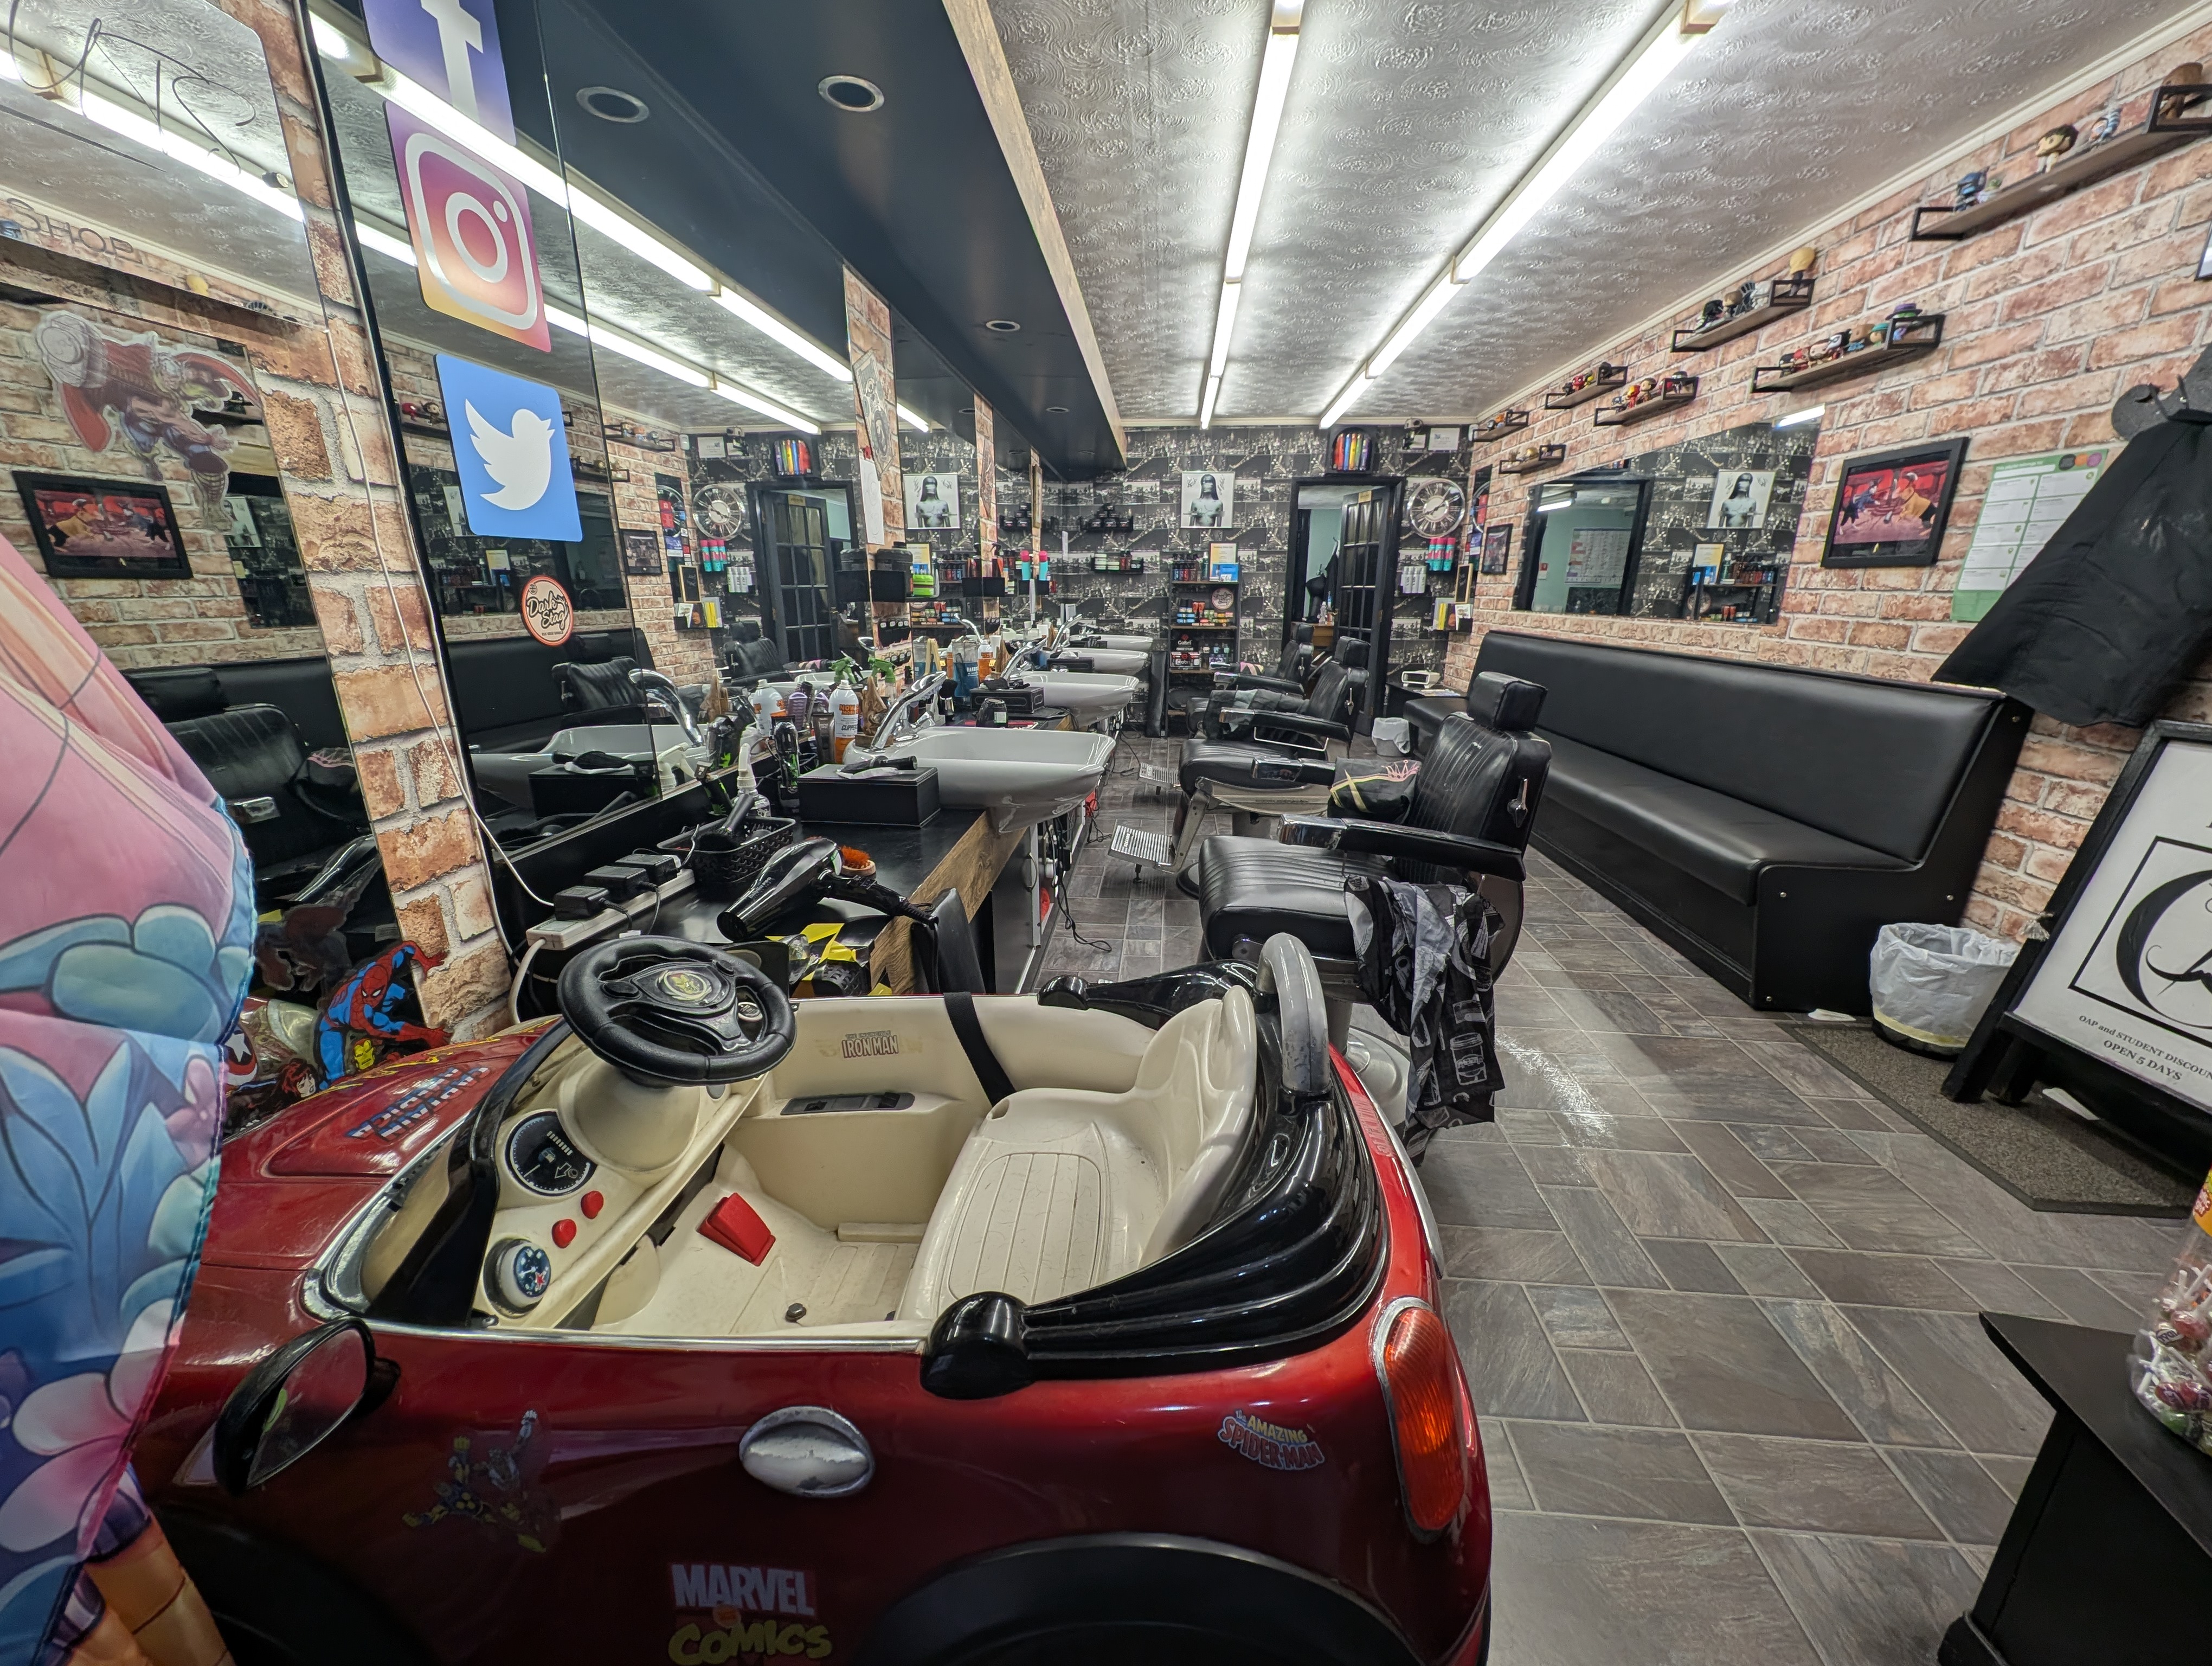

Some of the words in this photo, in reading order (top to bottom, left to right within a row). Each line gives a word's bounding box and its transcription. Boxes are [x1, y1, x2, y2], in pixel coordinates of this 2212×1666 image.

[7, 197, 134, 255] SHOP
[526, 590, 557, 618] Dark
[541, 609, 566, 631] Stag
[841, 1038, 872, 1059] IRON
[872, 1035, 899, 1056] MAN
[2079, 1015, 2099, 1027] OAP
[2098, 1024, 2117, 1035] and
[2115, 1032, 2165, 1058] STUDENT
[2104, 1040, 2137, 1060] OPEN
[2136, 1056, 2146, 1066] 5
[2146, 1059, 2183, 1081] DAYS
[1219, 1417, 1324, 1469] SPIDER-MAN
[1248, 1415, 1308, 1443] AMAZING
[671, 1564, 815, 1616] MARVEL
[668, 1619, 833, 1665] COMICS
